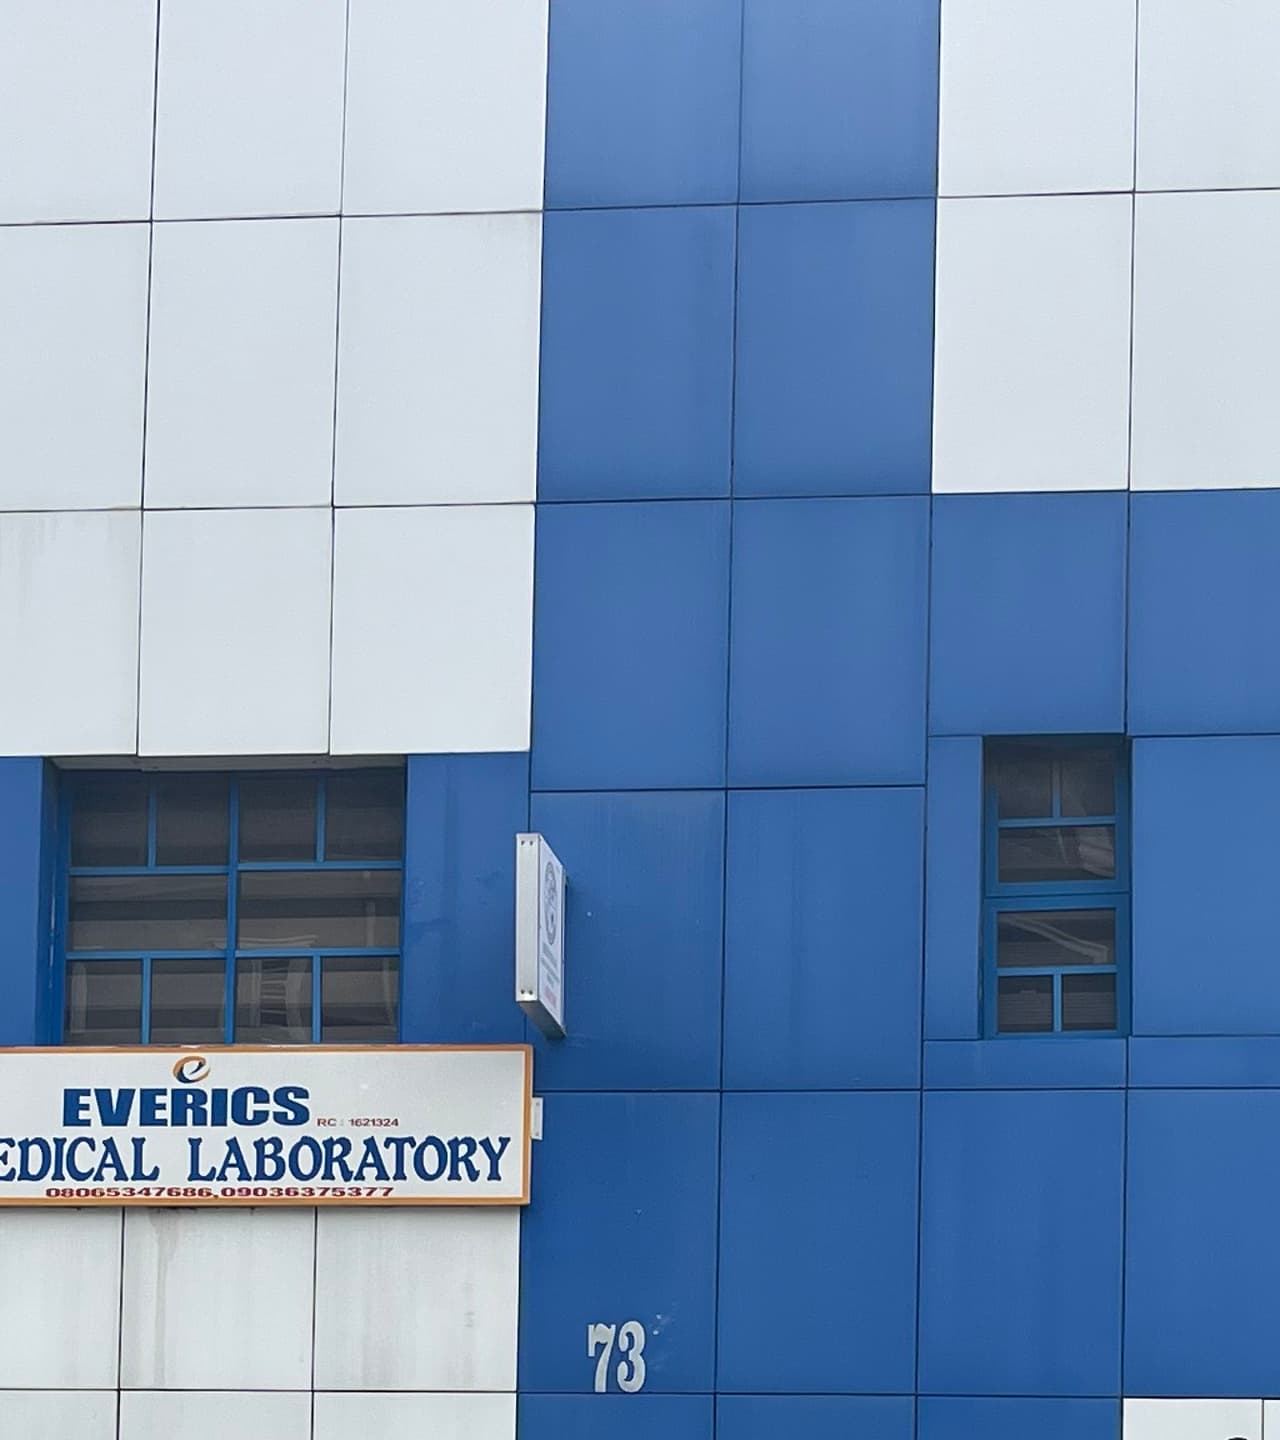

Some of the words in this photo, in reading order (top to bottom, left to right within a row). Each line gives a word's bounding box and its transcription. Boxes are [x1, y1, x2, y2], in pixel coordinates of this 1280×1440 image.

[62, 1086, 311, 1128] EVERICS
[348, 1118, 399, 1127] 1621324
[187, 1134, 512, 1183] LABORATORY
[587, 1320, 646, 1393] 73
